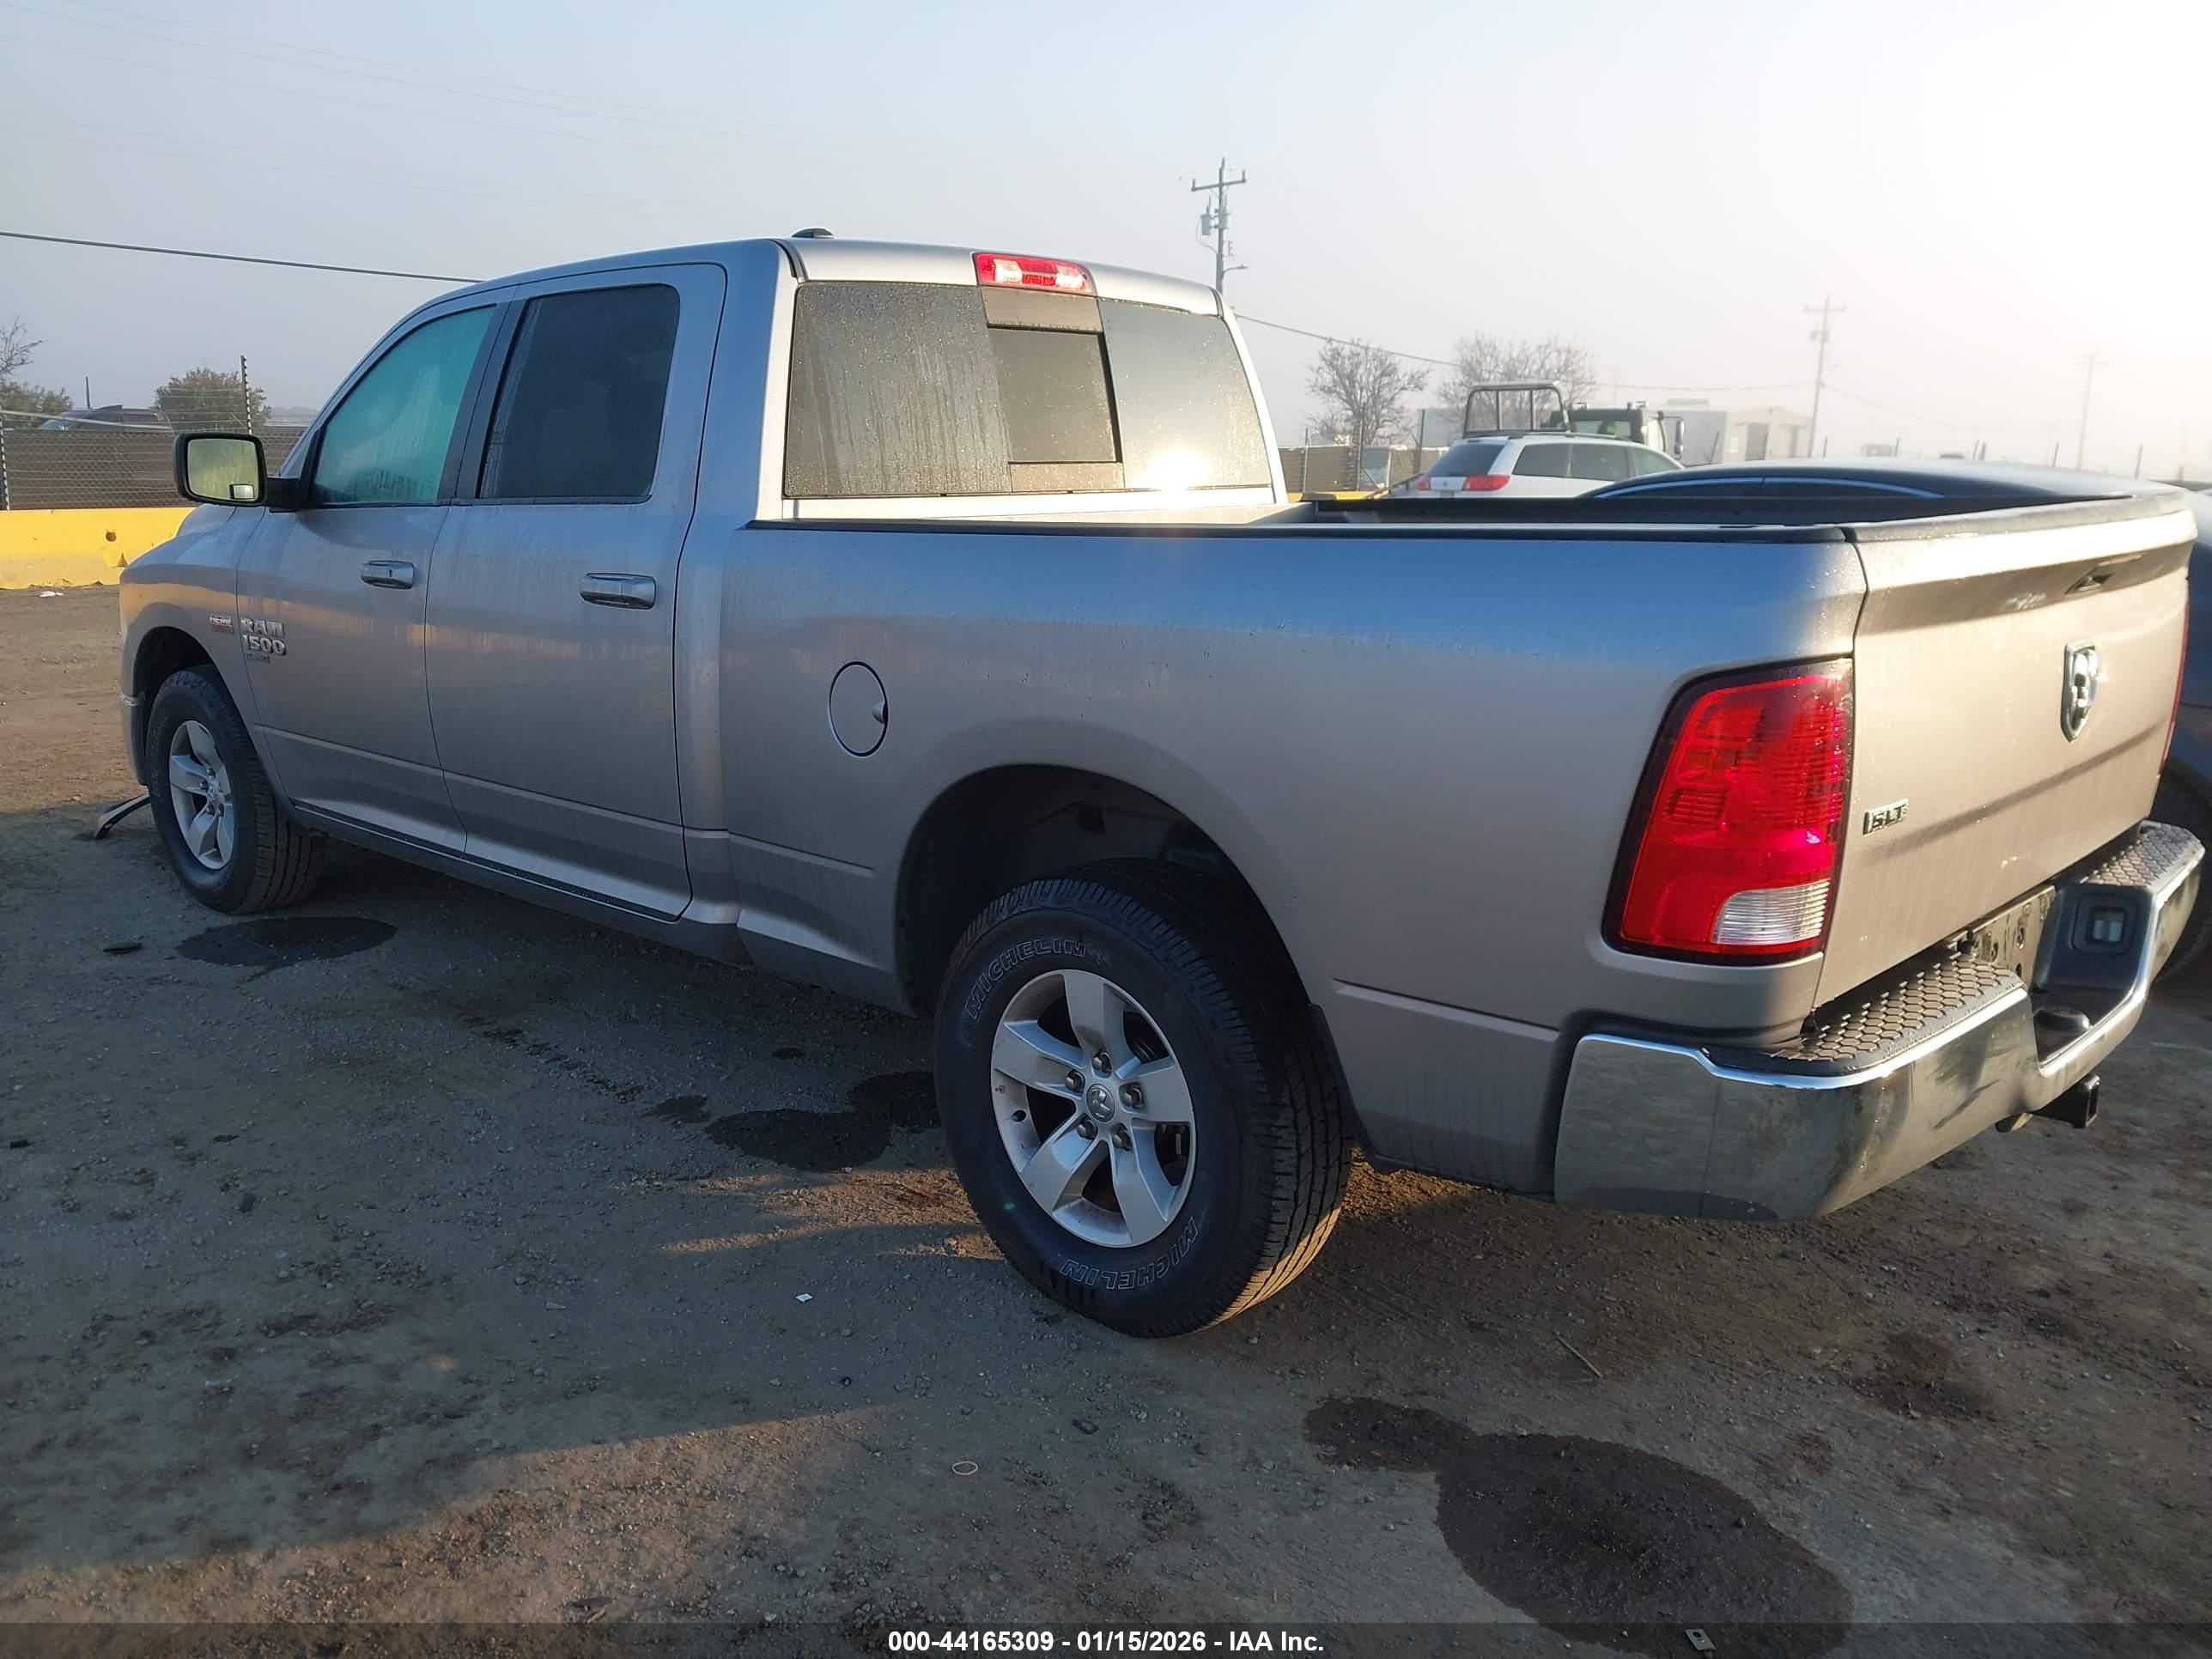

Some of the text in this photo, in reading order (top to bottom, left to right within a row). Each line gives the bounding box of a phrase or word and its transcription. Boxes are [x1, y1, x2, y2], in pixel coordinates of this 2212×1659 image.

[240, 617, 285, 638] RAM
[242, 634, 287, 656] 1500
[1867, 799, 1909, 834] SLT
[964, 938, 1087, 1019] MICHELIN
[1059, 1215, 1200, 1290] MICHELIN
